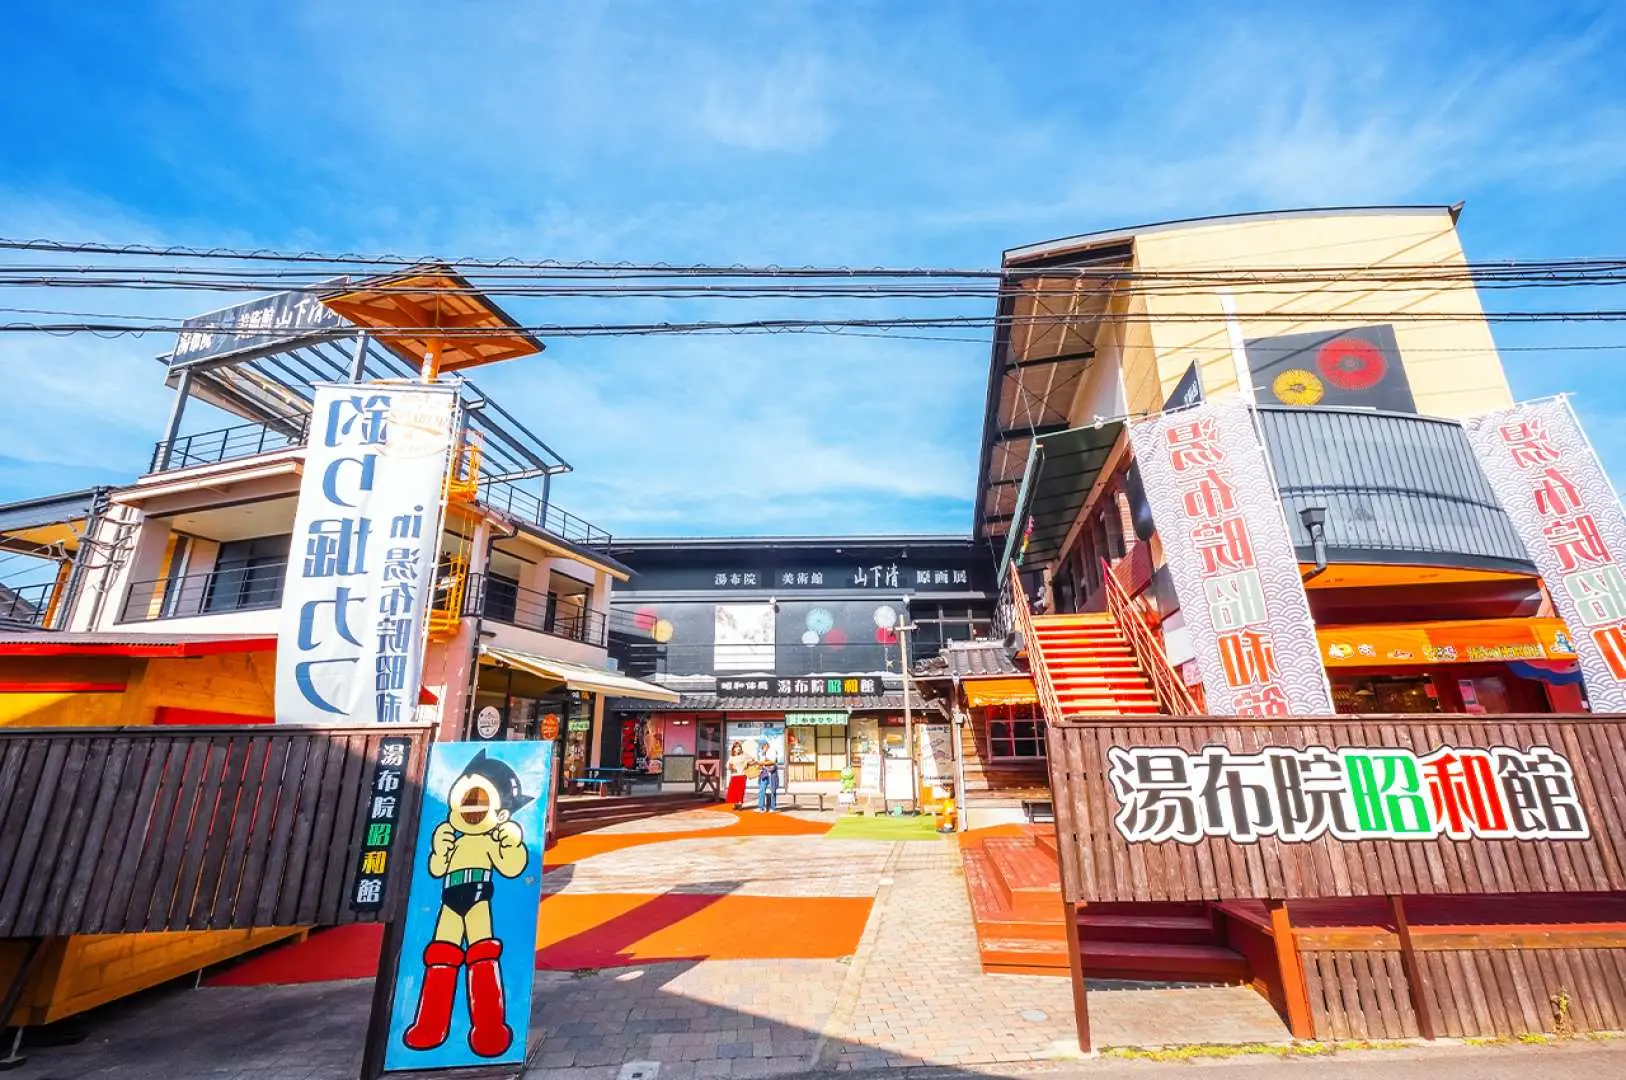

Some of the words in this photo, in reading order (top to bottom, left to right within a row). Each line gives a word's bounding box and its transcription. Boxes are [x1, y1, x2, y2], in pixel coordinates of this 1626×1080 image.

[714, 572, 757, 586] 湯布院
[782, 572, 823, 586] 美術館
[853, 563, 899, 588] 山下清
[777, 679, 874, 694] 湯布院昭和館
[1118, 751, 1585, 838] 湯布院昭和館
[356, 744, 405, 903] 湯布院昭和館
